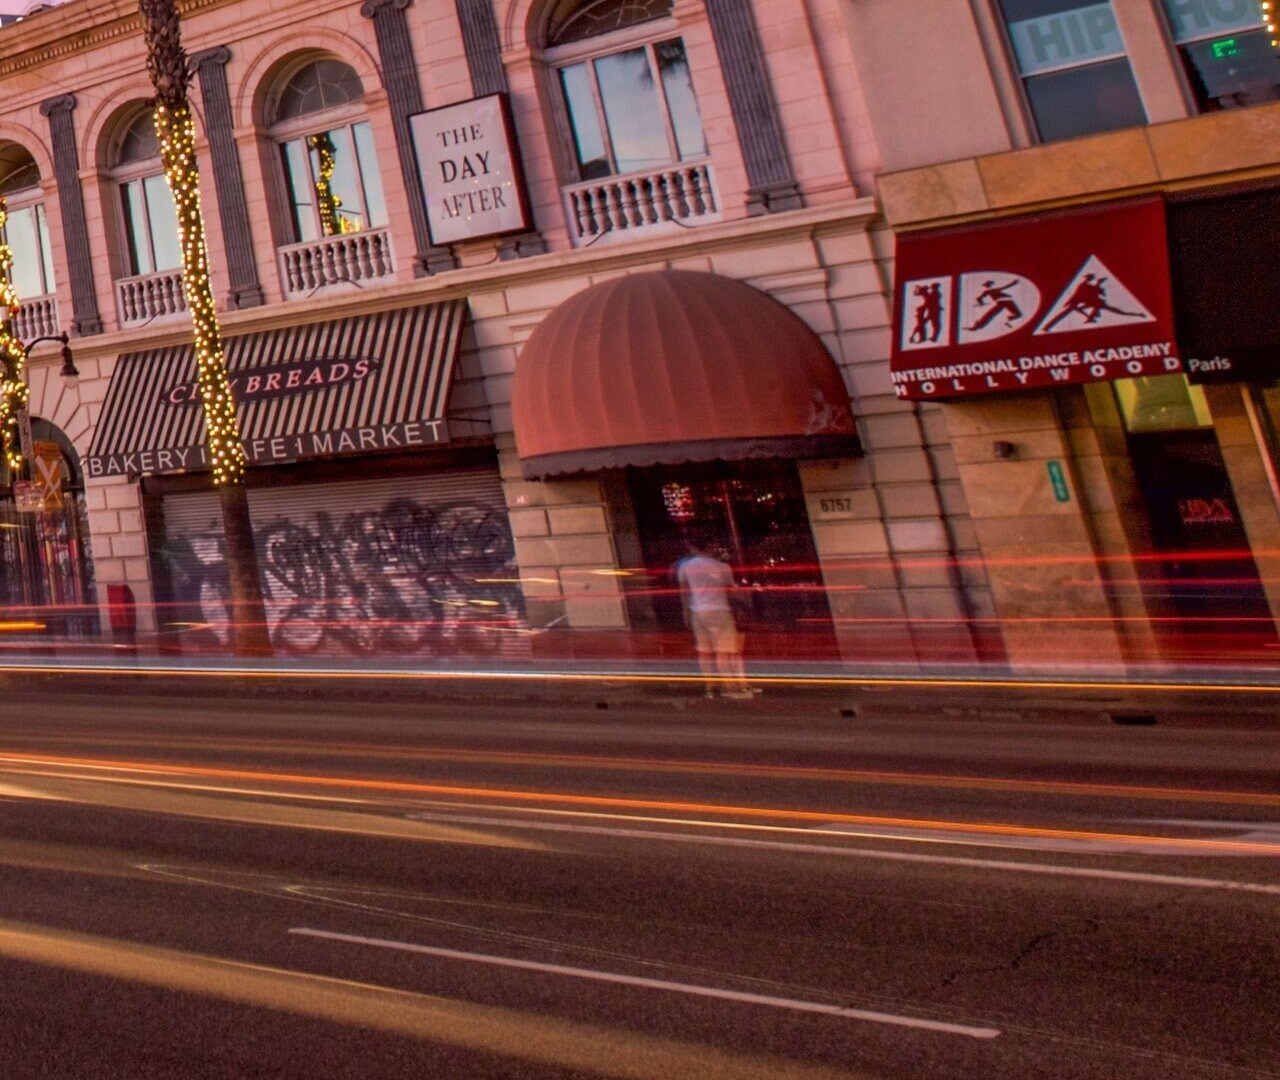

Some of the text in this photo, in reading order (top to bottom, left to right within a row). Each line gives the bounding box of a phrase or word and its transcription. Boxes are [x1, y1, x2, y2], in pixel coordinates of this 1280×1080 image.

[1026, 7, 1118, 63] HIP
[436, 123, 484, 147] THE
[439, 150, 491, 184] DAY
[441, 186, 507, 220] AFTER
[900, 254, 1158, 351] IDA
[244, 358, 371, 395] BREADS
[891, 342, 1172, 383] INTERNATIONAL DANCE ACADEMY
[894, 356, 1180, 397] HOLLYWOOD
[1190, 355, 1232, 373] Paris
[91, 449, 190, 476] BAKERY
[313, 421, 443, 455] MARKET
[820, 498, 851, 513] 6757
